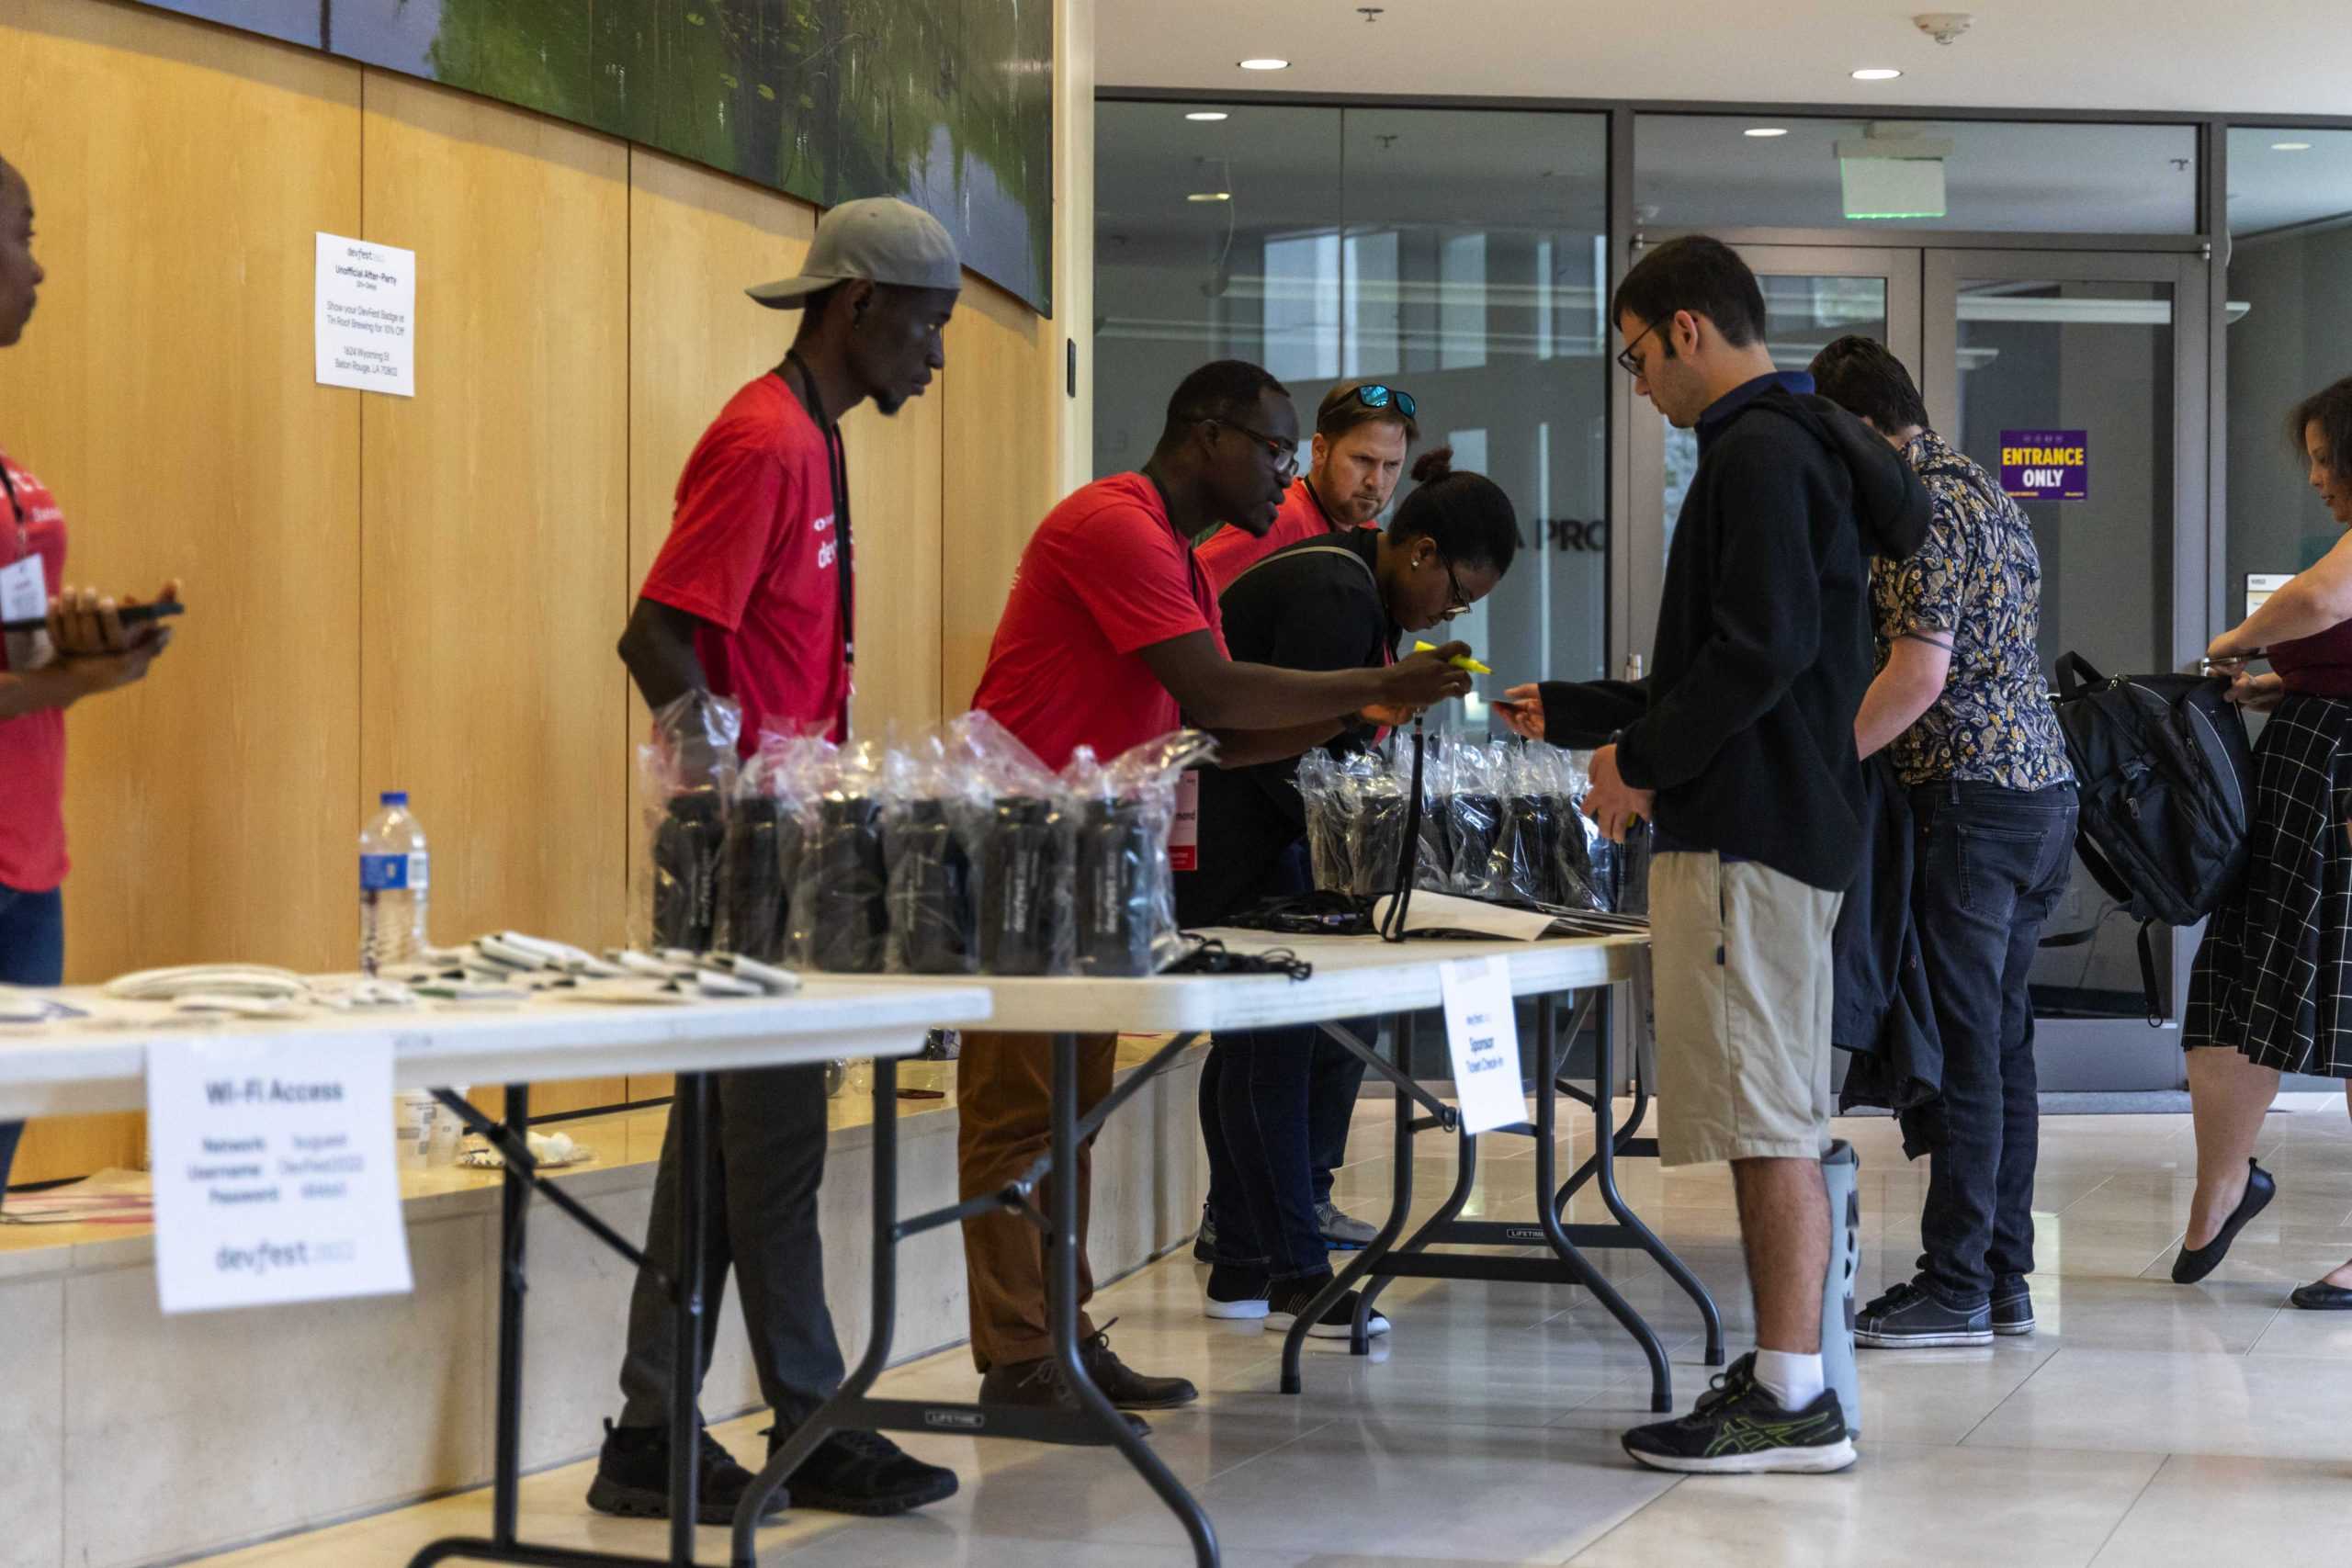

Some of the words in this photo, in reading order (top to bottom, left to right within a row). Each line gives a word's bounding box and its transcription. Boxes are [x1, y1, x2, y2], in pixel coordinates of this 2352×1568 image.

[335, 264, 363, 278] Unofficial
[364, 269, 397, 287] After-Party
[327, 300, 344, 312] Show
[352, 318, 373, 333] Brewing
[374, 322, 382, 333] for
[357, 347, 382, 363] Wyoming
[2002, 447, 2084, 466] ENTRANCE
[2022, 468, 2064, 488] ONLY
[205, 1078, 264, 1104] Wi-Fi
[268, 1081, 345, 1102] Access
[215, 1240, 309, 1276] devfest
